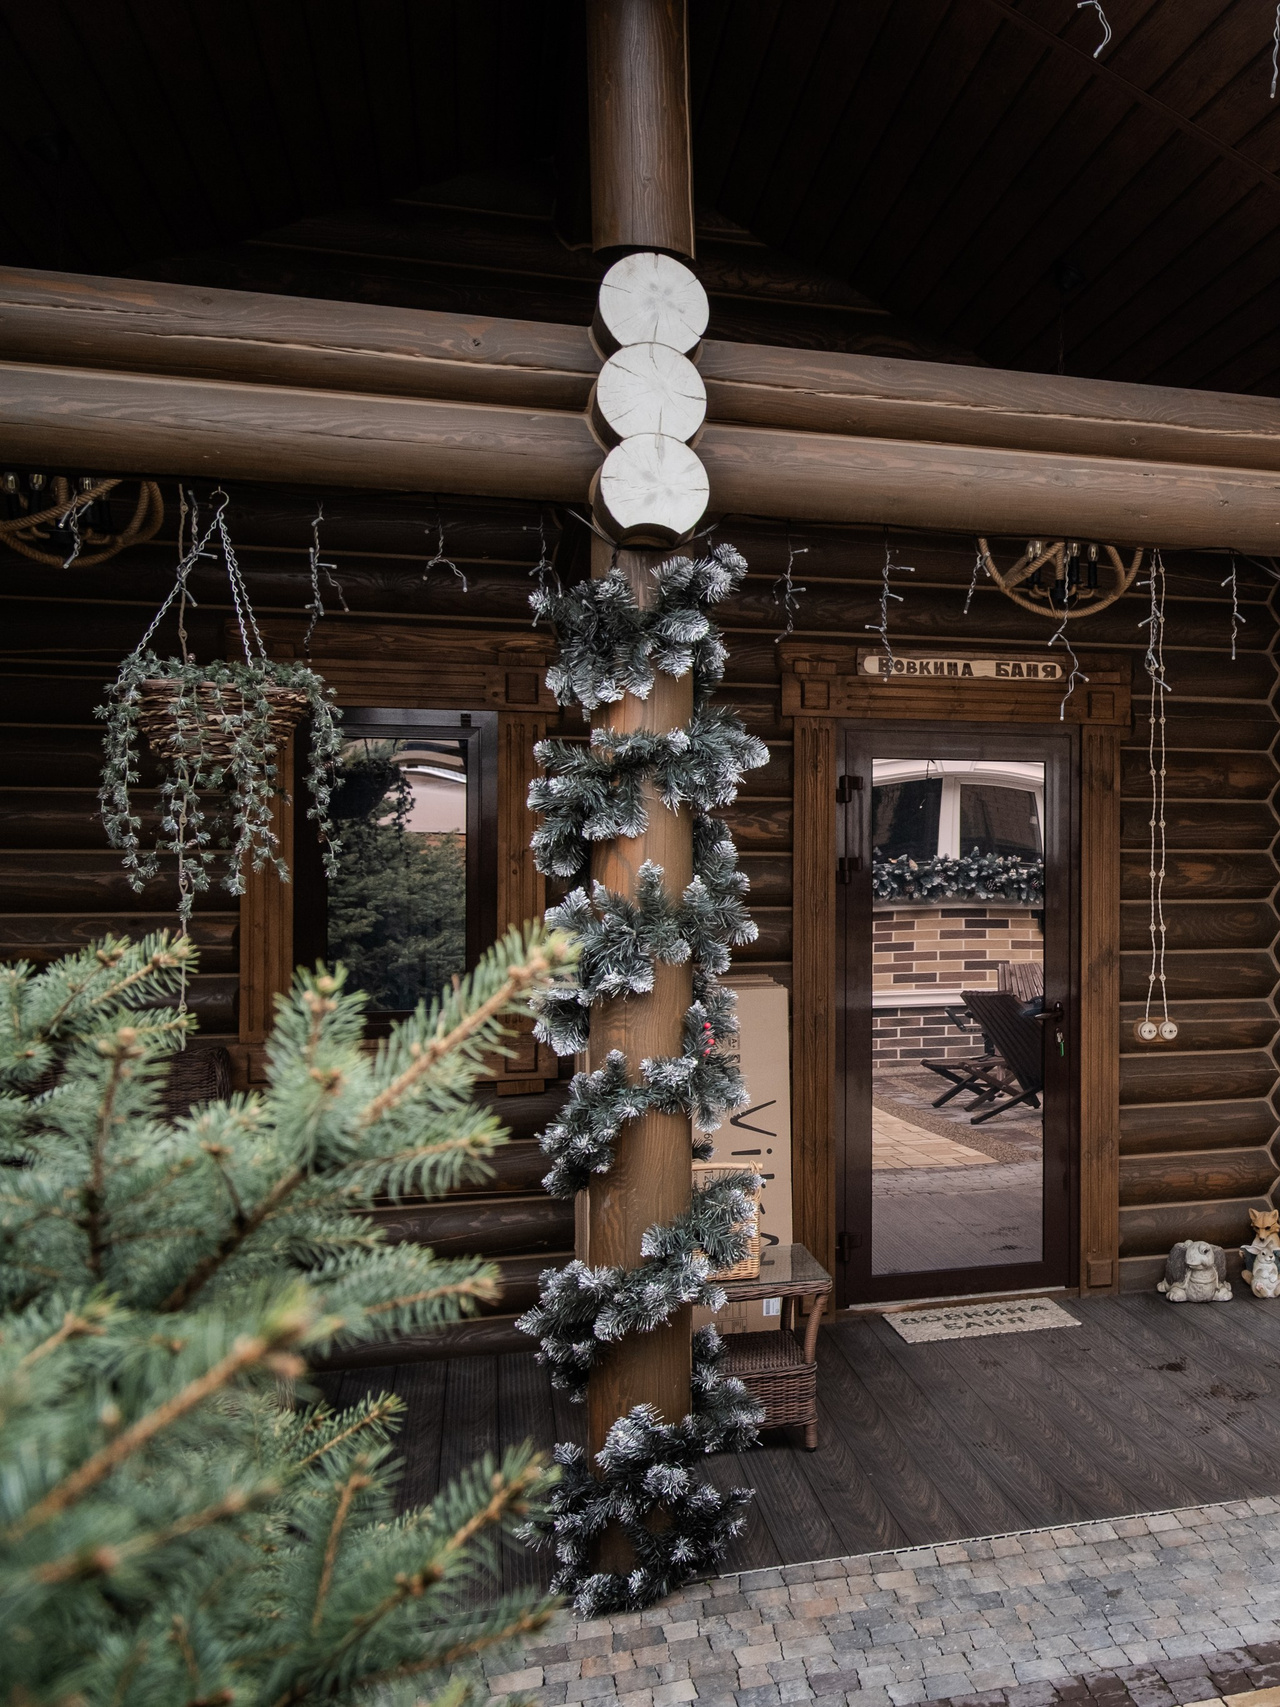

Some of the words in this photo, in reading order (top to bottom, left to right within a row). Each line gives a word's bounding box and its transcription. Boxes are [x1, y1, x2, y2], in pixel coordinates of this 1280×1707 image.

[878, 657, 975, 677] ВОВКИНА
[995, 662, 1057, 679] БАНЯ
[901, 1305, 1049, 1325] ВОВКИНА
[944, 1316, 1027, 1331] БАНЯ
